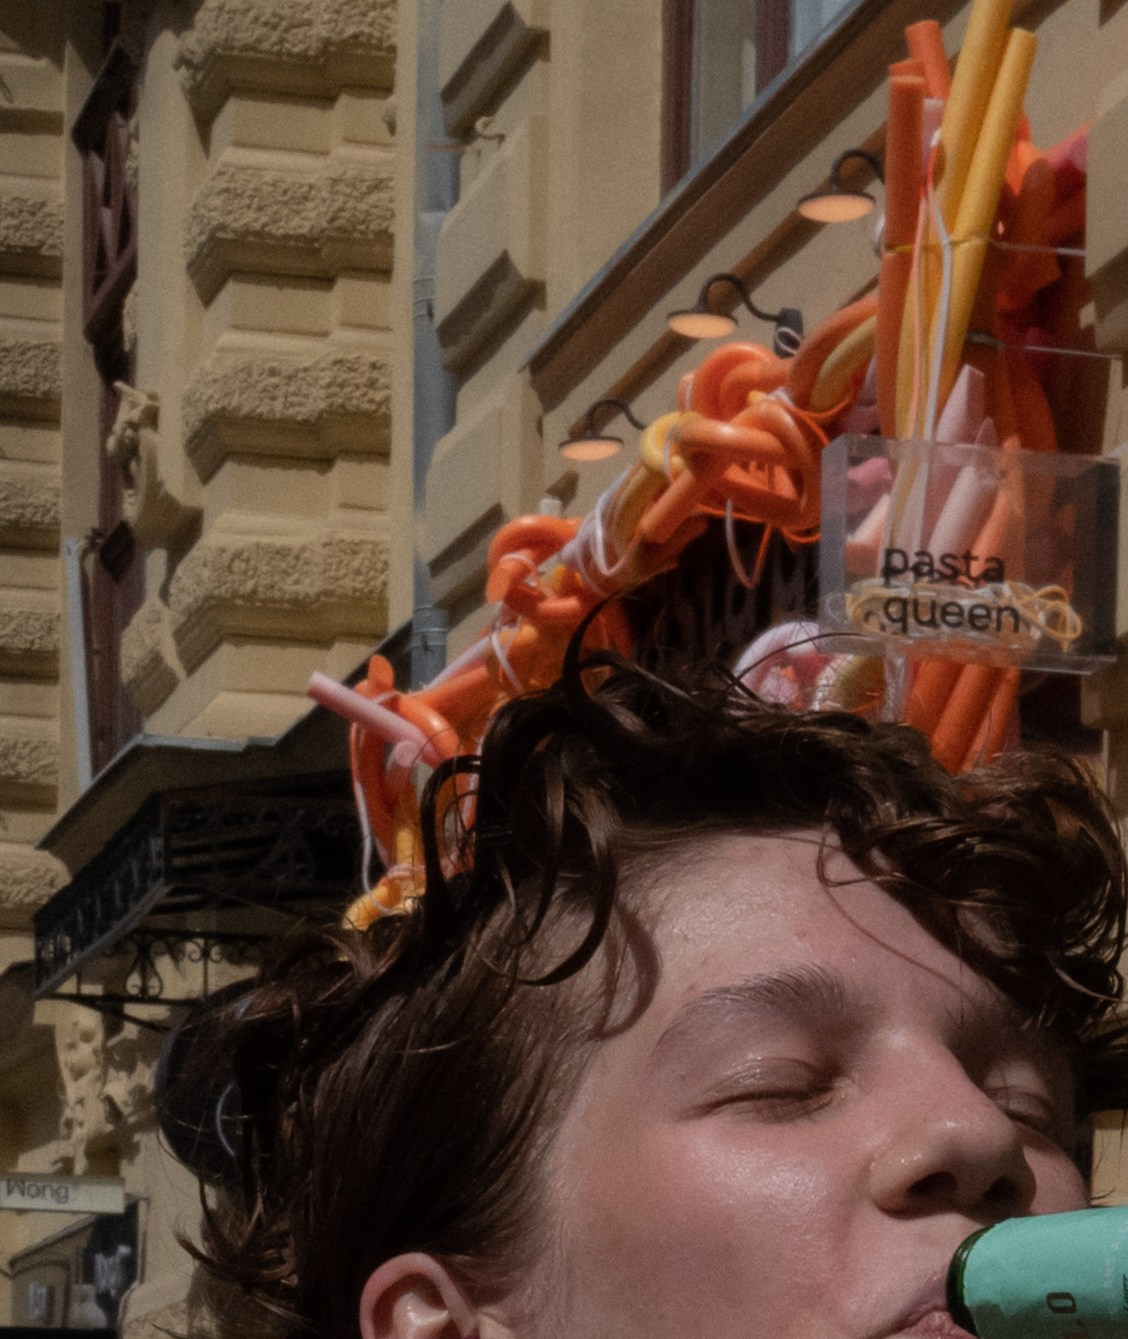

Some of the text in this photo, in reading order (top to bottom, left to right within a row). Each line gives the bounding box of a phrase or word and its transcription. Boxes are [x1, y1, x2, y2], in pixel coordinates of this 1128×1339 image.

[884, 547, 1005, 588] pasta
[884, 597, 1021, 634] queen
[6, 1178, 69, 1204] Wong
